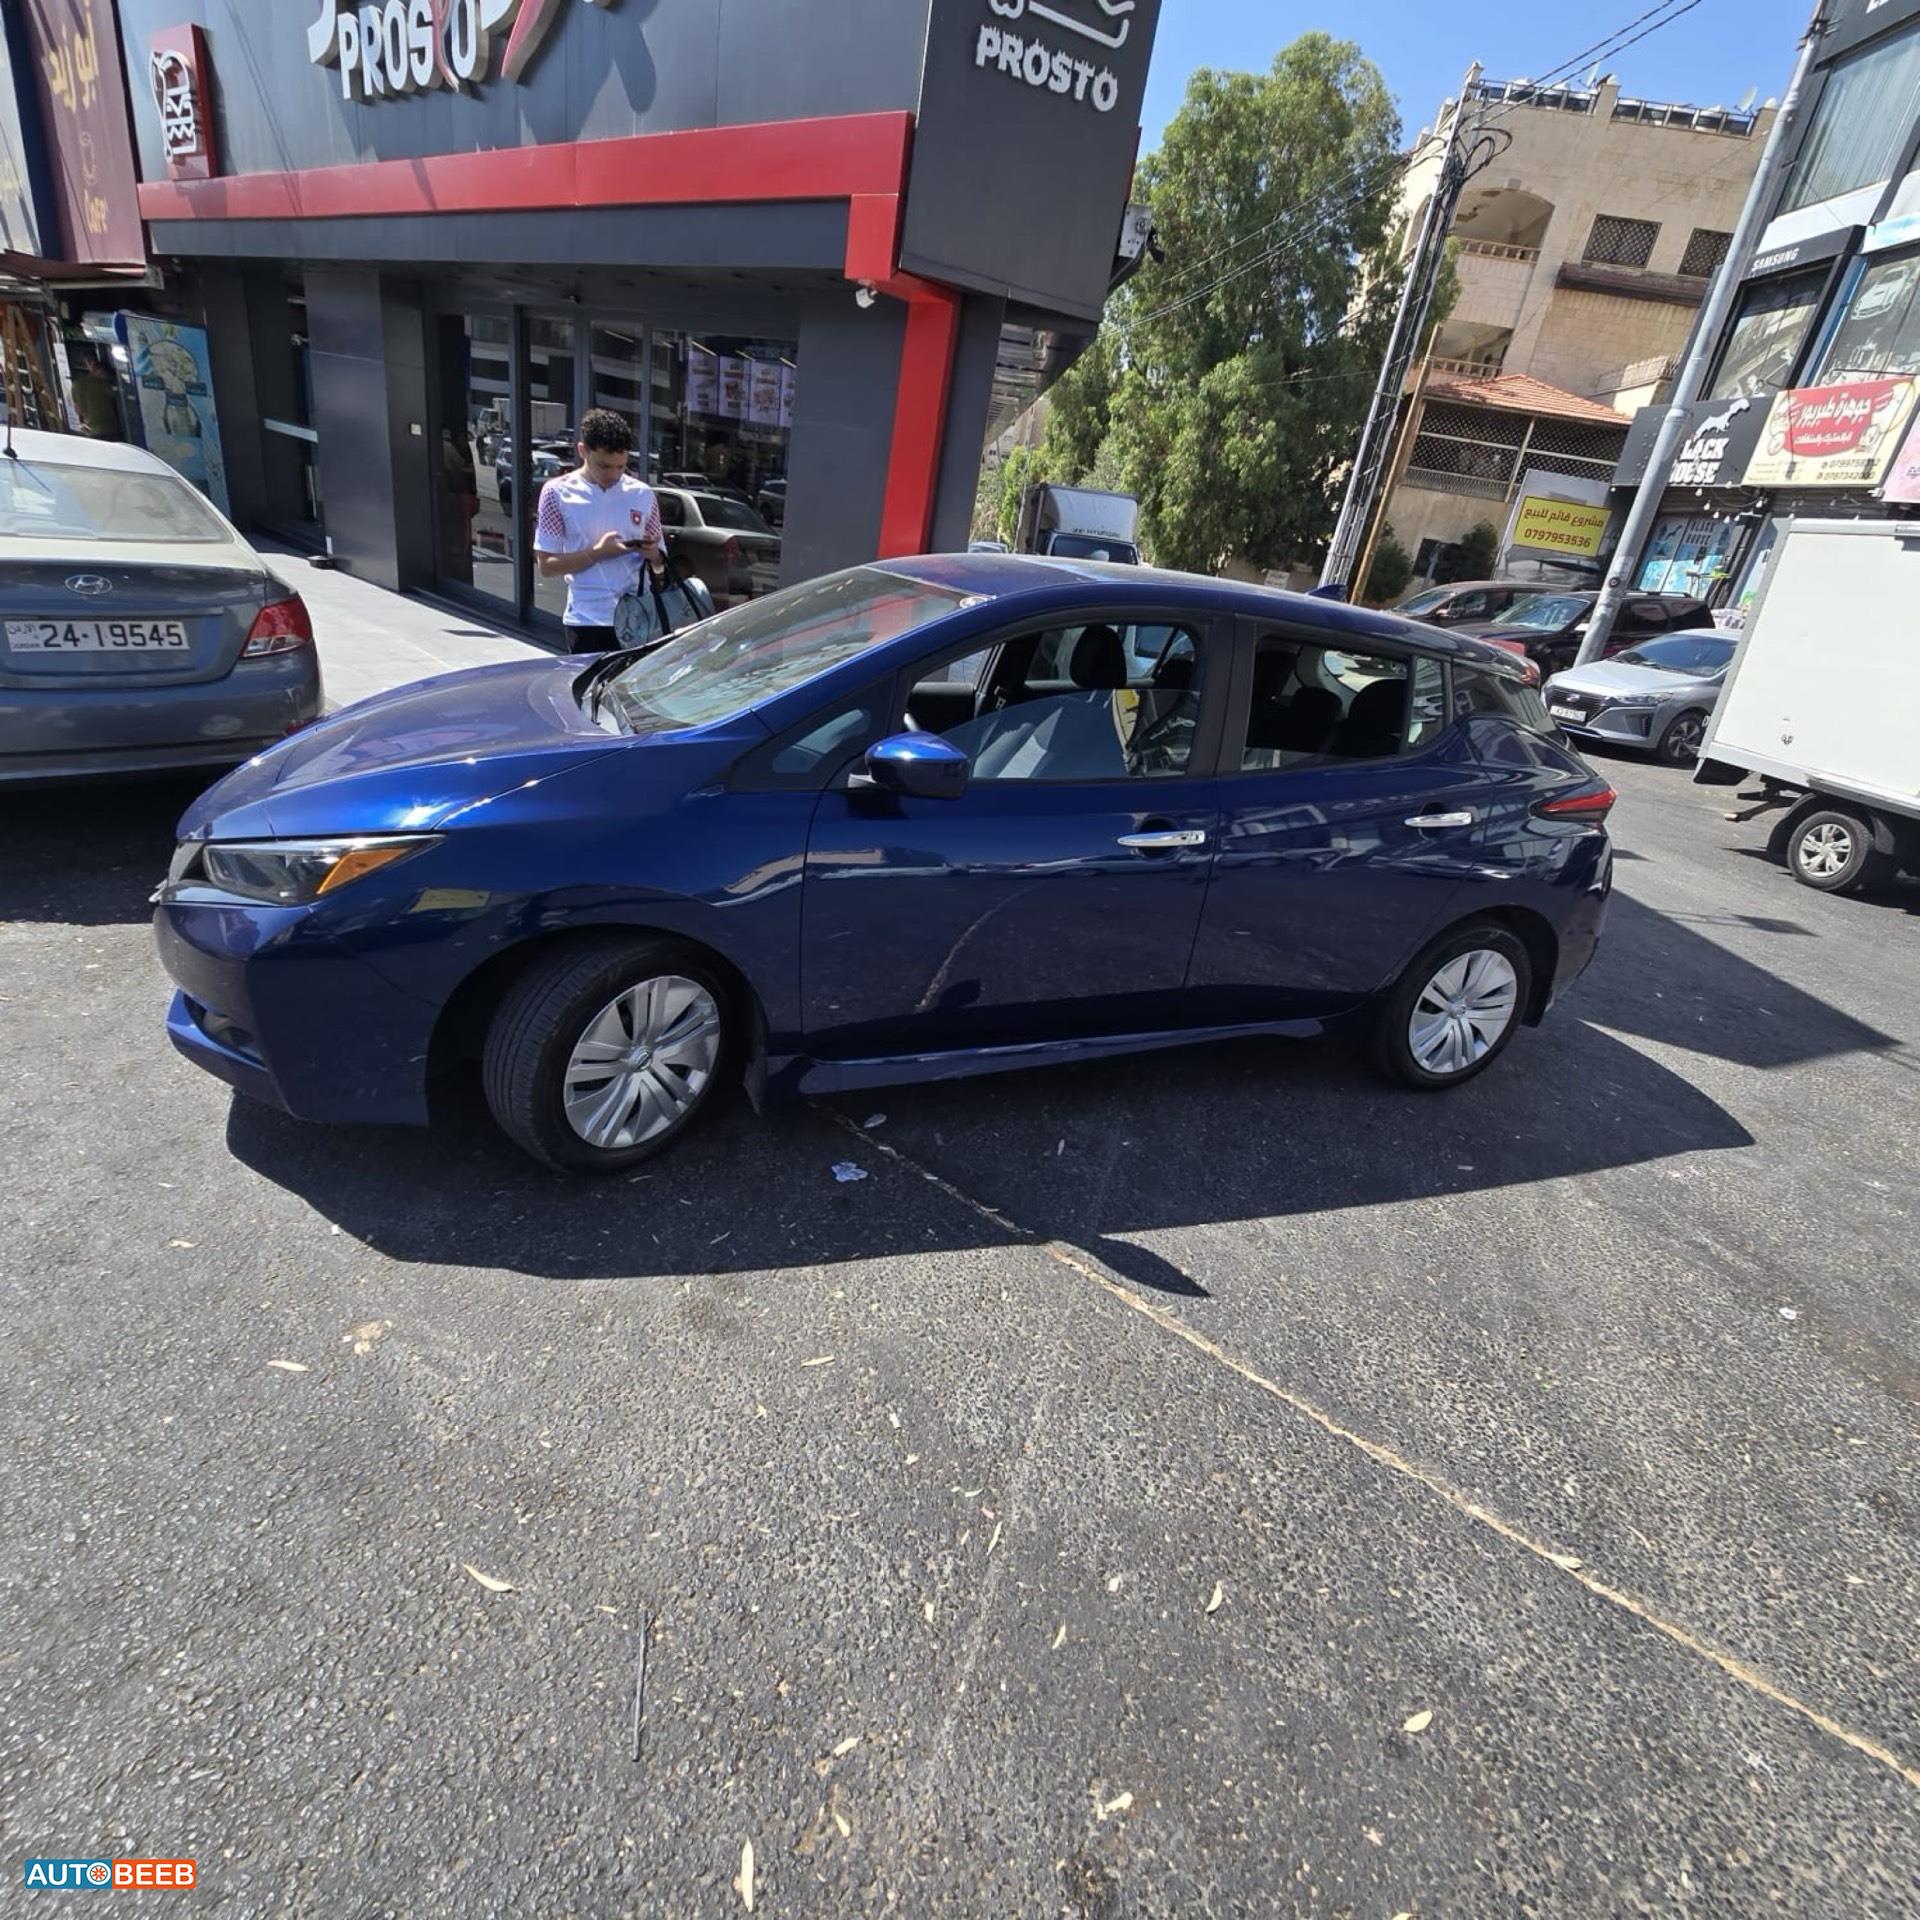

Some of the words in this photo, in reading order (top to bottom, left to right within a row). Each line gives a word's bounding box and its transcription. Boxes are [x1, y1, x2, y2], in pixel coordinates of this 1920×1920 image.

[975, 24, 1118, 112] PROSTO
[1753, 248, 1799, 268] SAMSUNG
[1680, 437, 1730, 461] LACK
[1524, 507, 1549, 520] للبيع
[1548, 510, 1570, 523] قائم
[1570, 516, 1604, 528] مشروع
[1524, 528, 1592, 548] 0797953536
